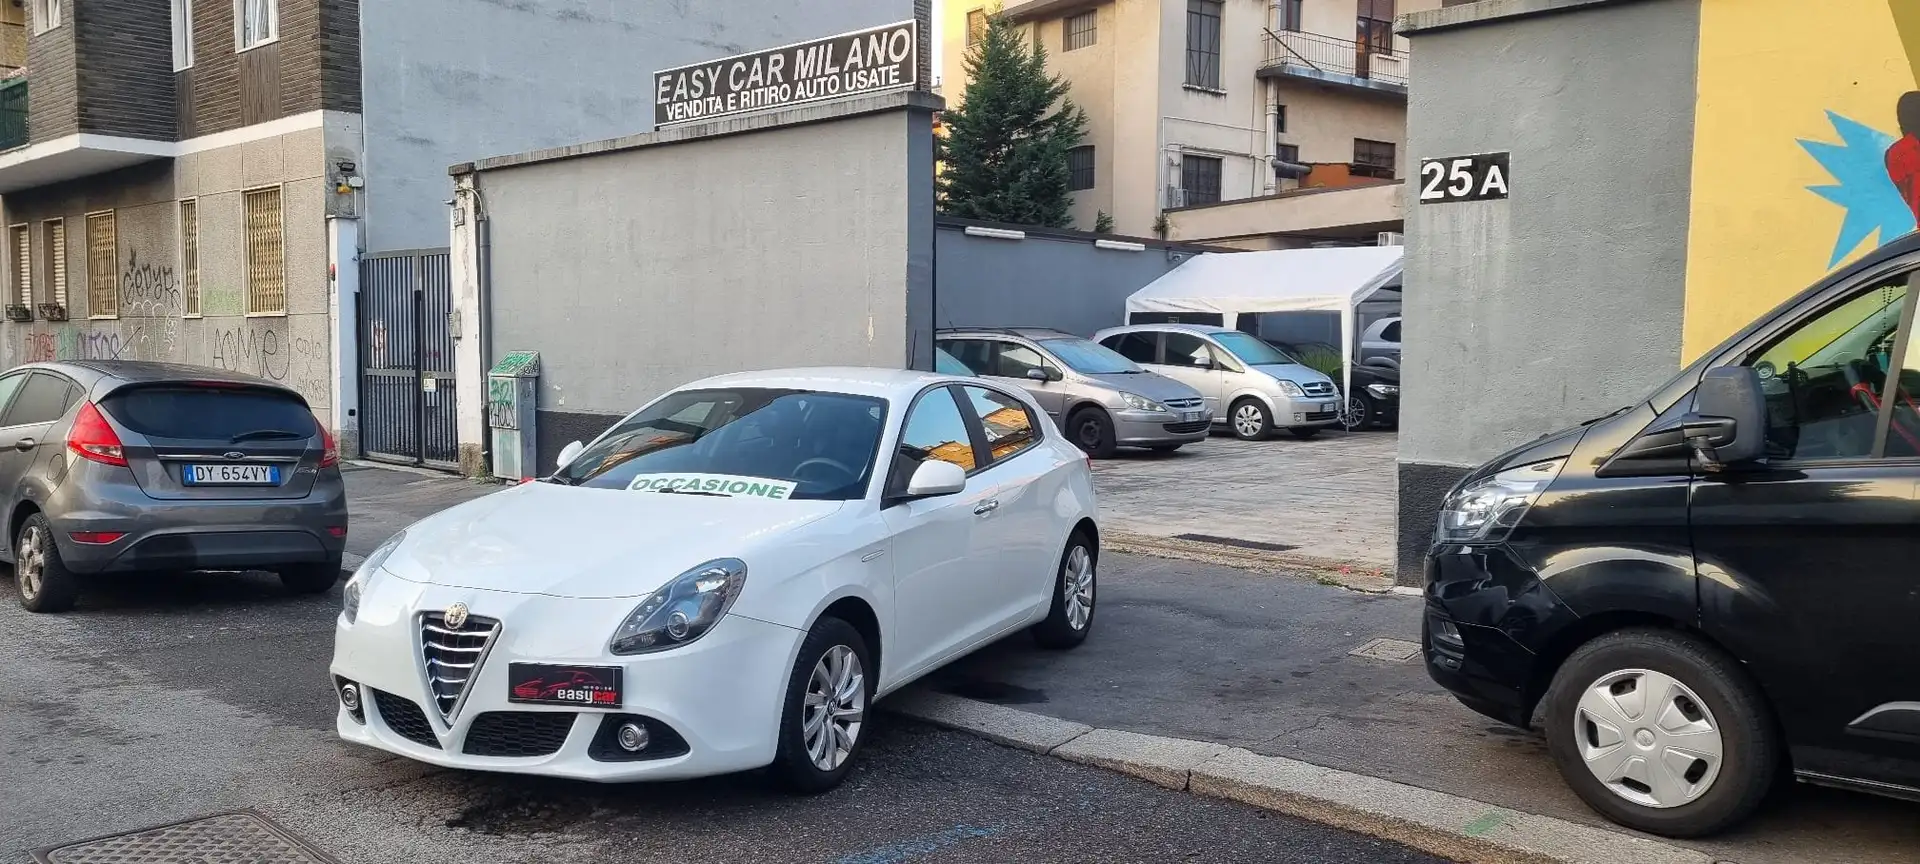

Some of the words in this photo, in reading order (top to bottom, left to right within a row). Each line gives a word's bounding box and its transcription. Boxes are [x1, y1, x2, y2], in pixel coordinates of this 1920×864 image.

[657, 65, 723, 104] EASY
[729, 53, 785, 92] CAR
[793, 27, 911, 80] MILANO
[666, 96, 724, 121] VENDITA
[727, 93, 737, 111] E
[743, 83, 791, 109] RITIRO
[794, 74, 840, 100] AUTO
[844, 63, 900, 91] USATE
[221, 466, 269, 481] 654VY
[631, 477, 788, 499] OCCASIONE
[557, 689, 616, 704] easycar
